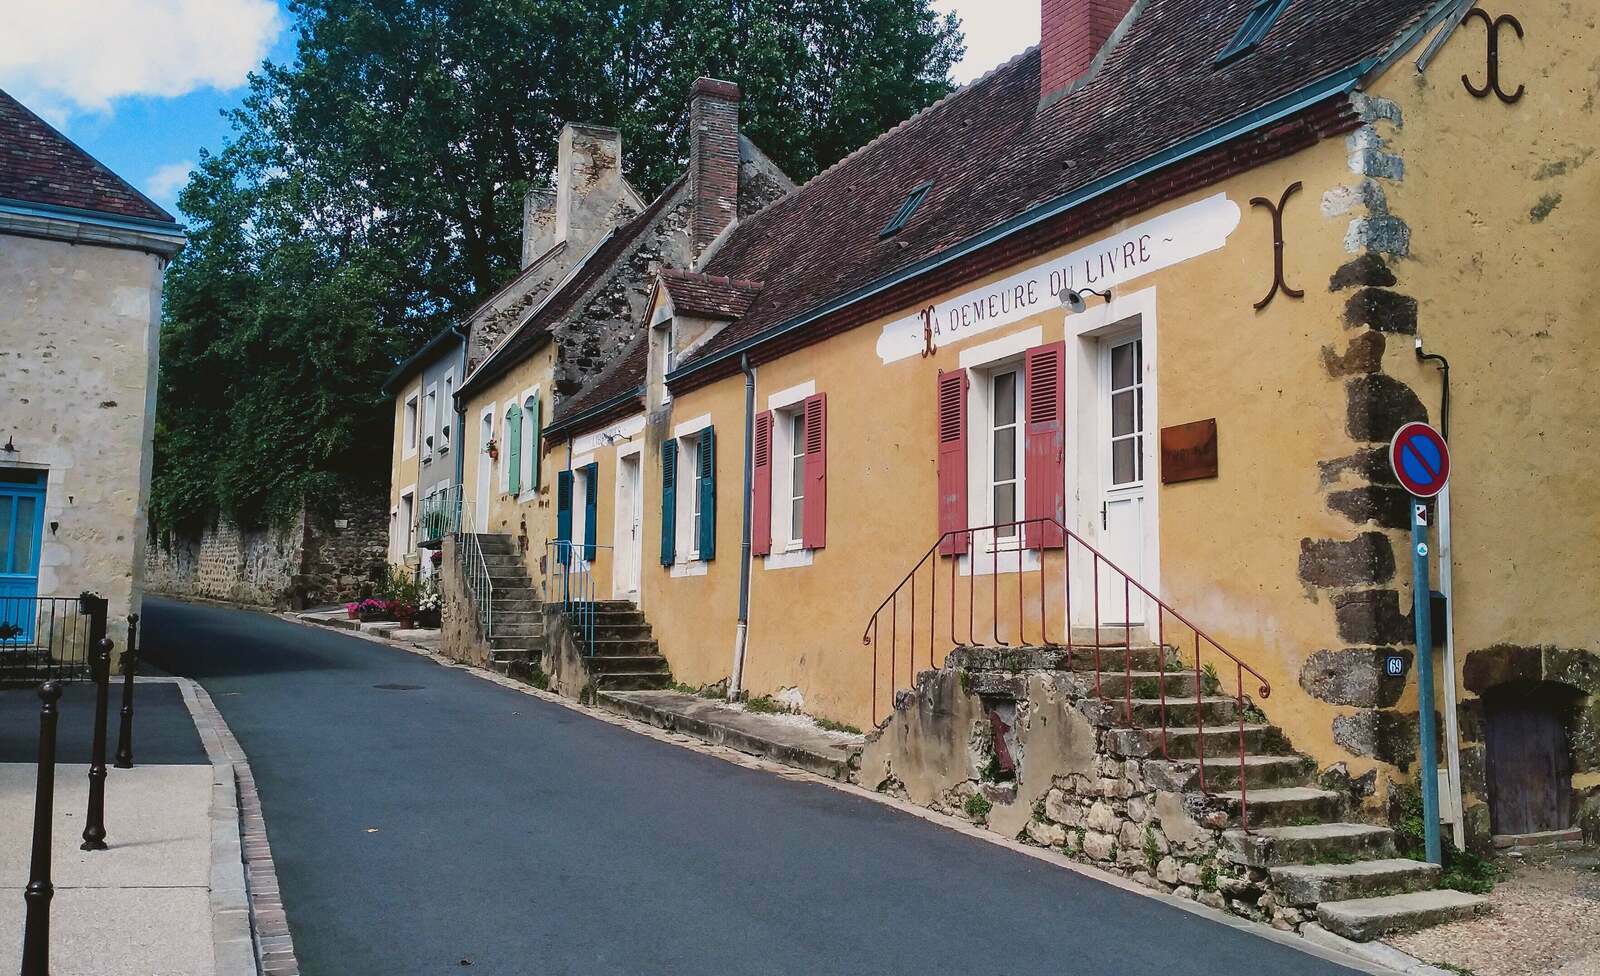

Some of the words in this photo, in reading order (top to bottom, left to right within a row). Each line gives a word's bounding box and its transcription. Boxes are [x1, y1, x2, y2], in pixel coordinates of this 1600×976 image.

[949, 279, 1039, 332] DEMEURE
[1050, 265, 1074, 296] DU
[1085, 234, 1151, 283] LIVRE
[1389, 658, 1402, 674] 69
